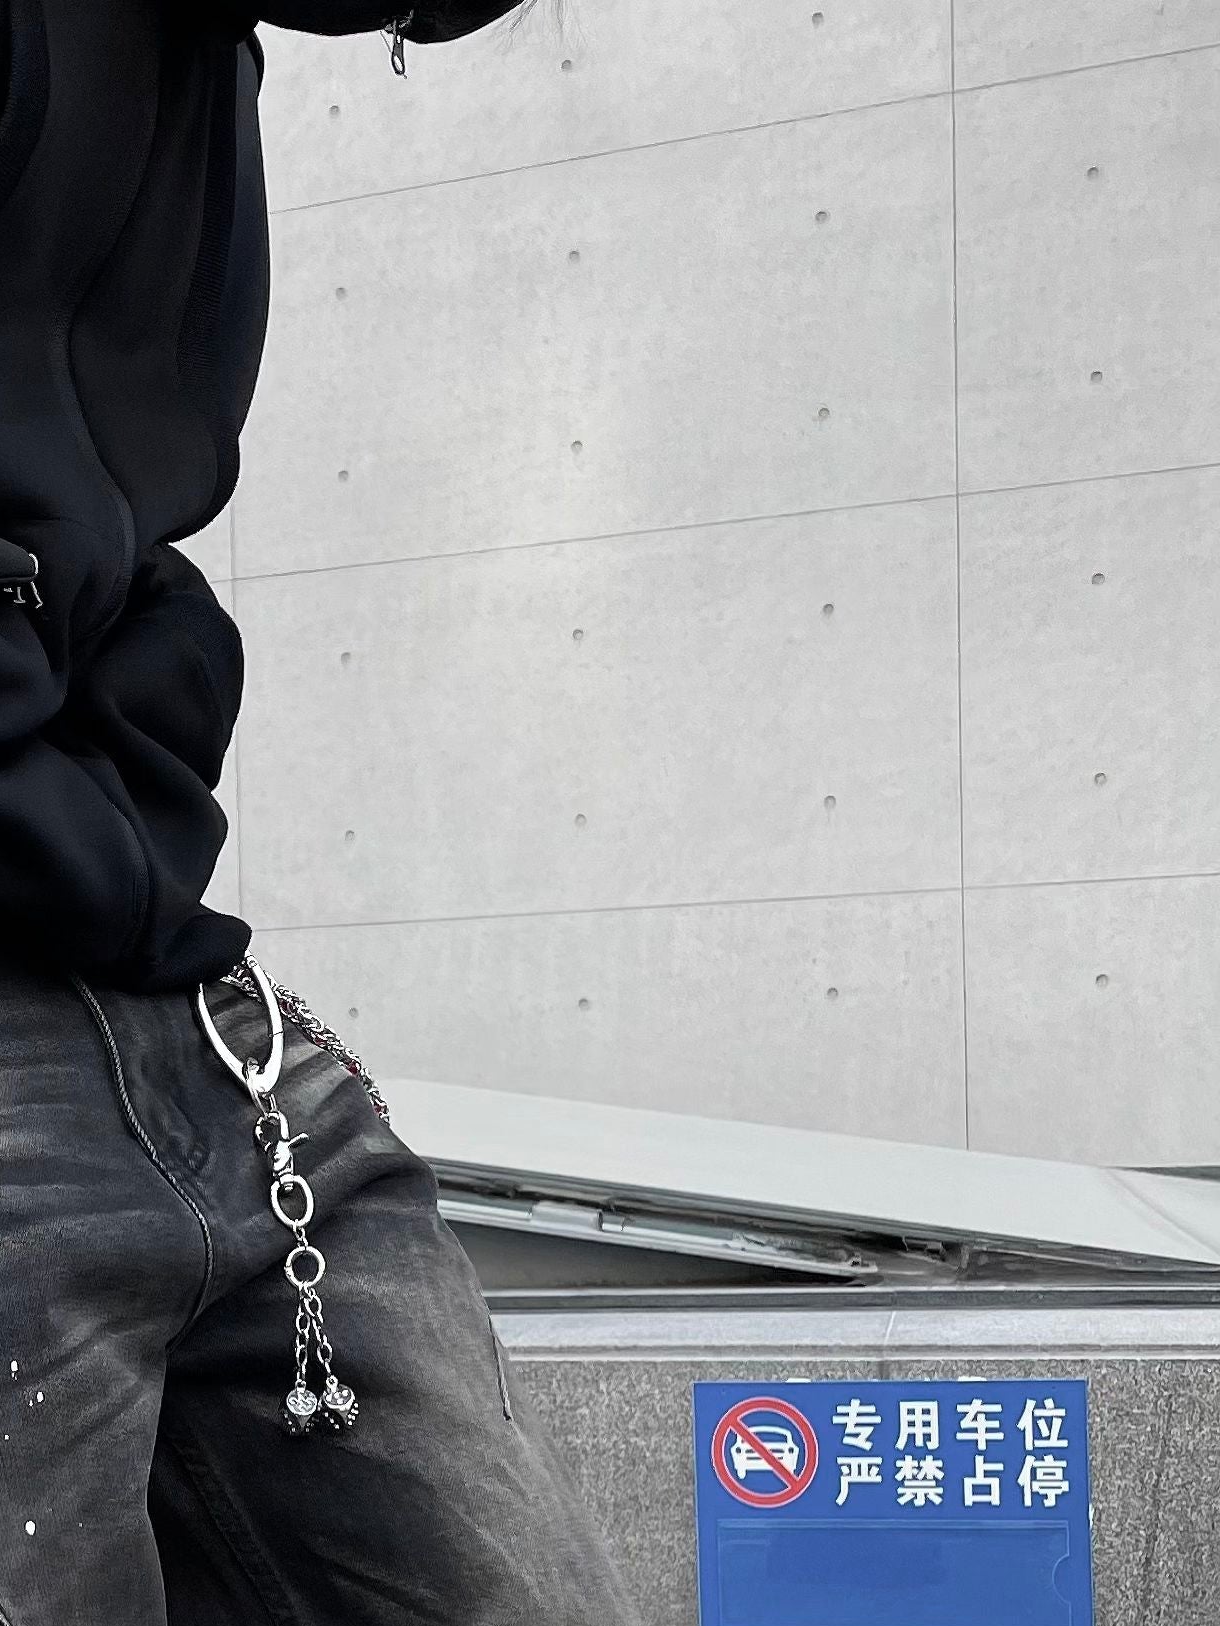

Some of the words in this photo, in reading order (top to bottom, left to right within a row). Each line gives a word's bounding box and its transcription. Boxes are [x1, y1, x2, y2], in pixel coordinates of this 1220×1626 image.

[832, 1398, 1069, 1450] 专用车位
[835, 1455, 1070, 1508] 严禁占停
